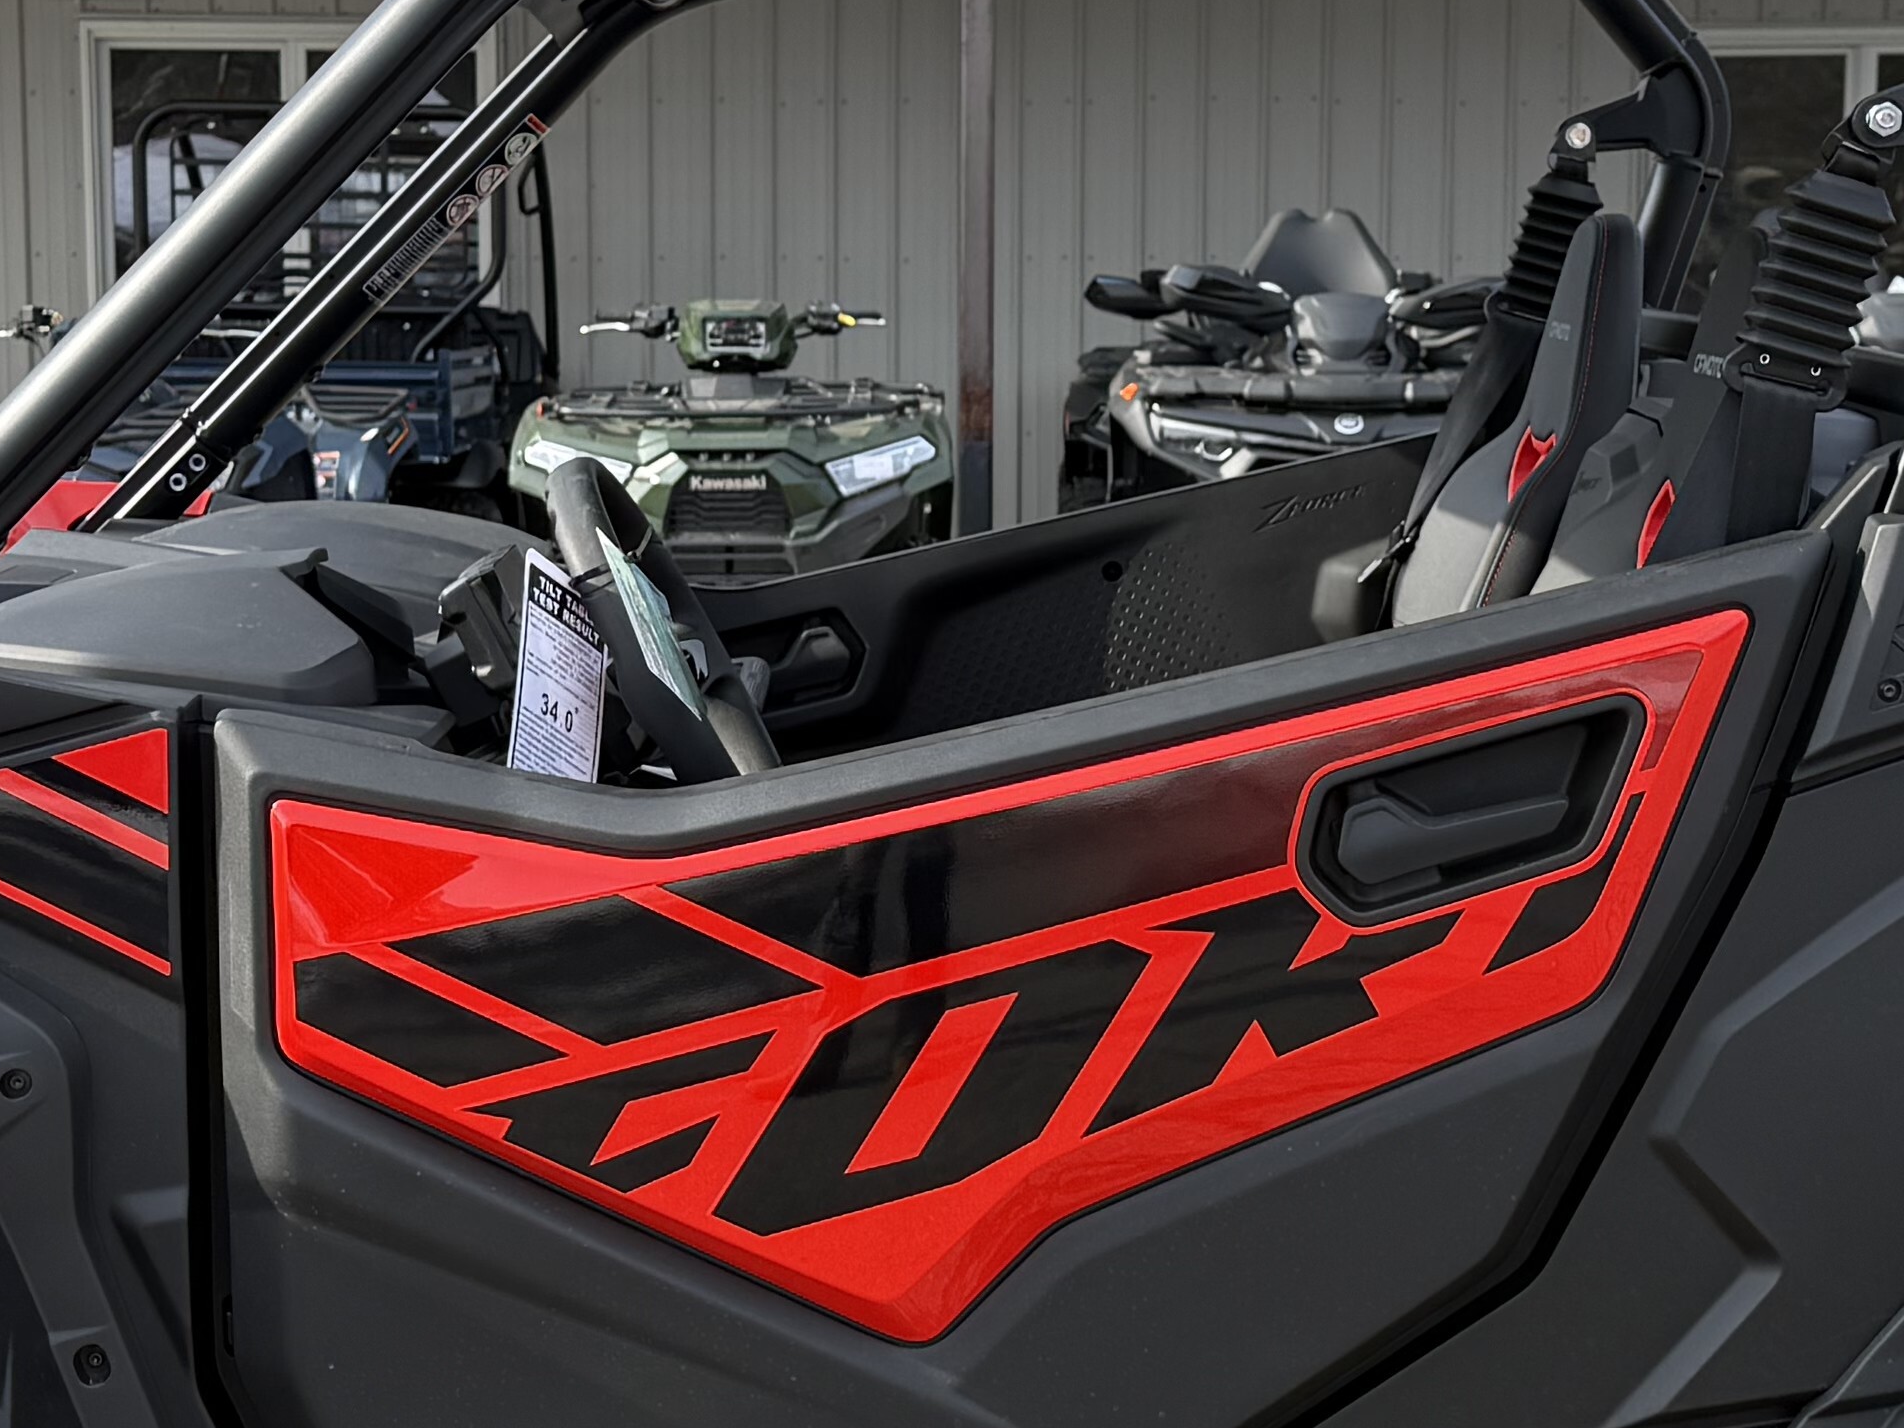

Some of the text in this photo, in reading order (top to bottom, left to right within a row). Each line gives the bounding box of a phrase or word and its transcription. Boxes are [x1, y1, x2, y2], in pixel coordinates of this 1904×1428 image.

[690, 474, 767, 491] Kawasaki
[532, 586, 600, 646] TEST RESULT
[538, 575, 595, 627] TILT TABL
